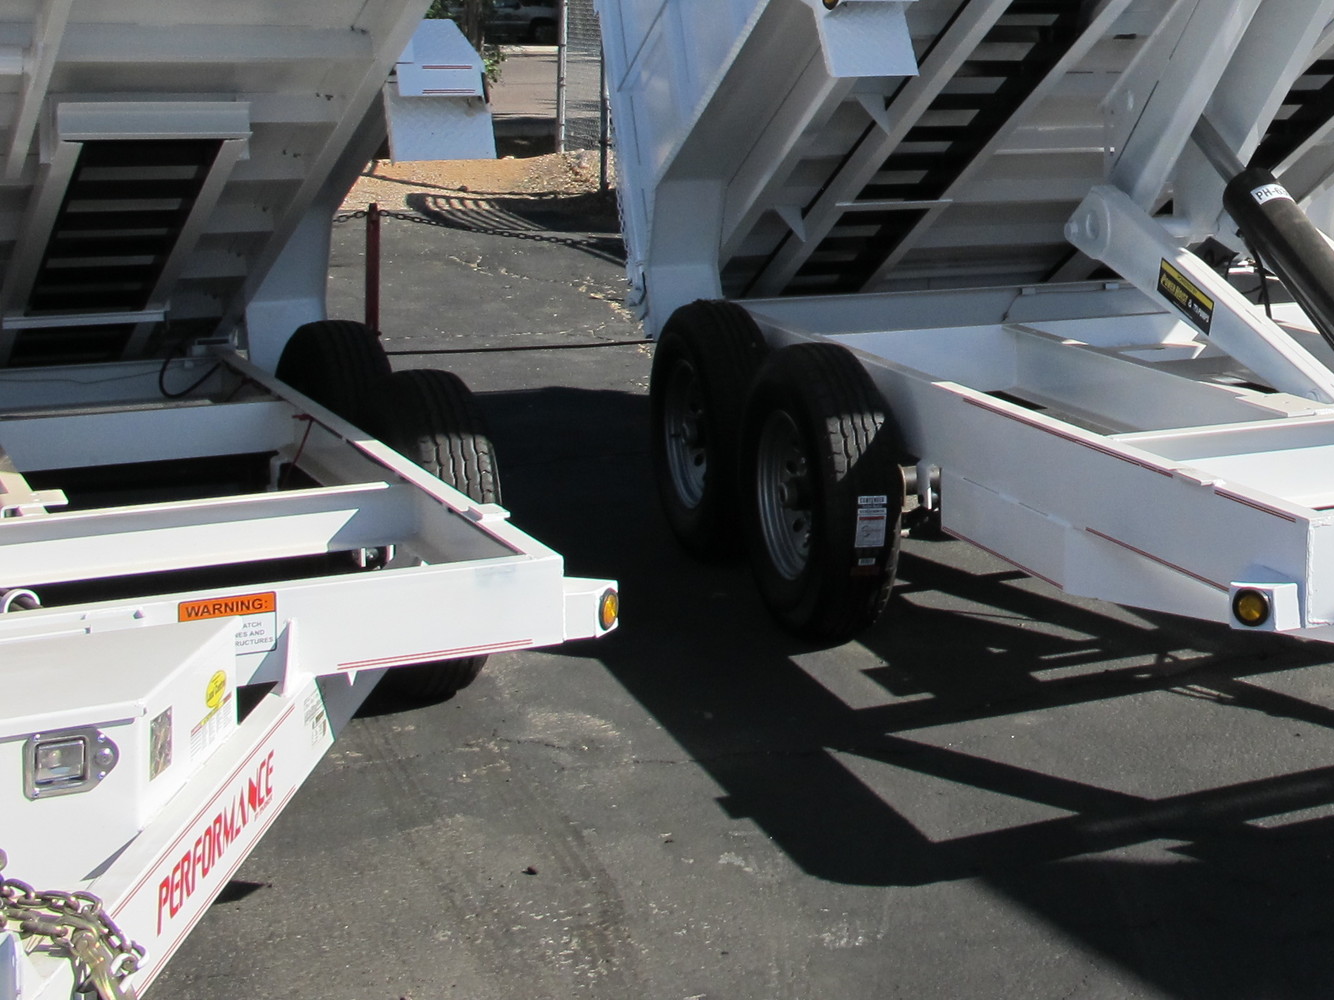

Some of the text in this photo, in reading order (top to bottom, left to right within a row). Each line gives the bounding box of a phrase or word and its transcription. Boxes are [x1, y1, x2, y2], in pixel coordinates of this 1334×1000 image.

[185, 598, 268, 618] WARNING:
[242, 621, 262, 630] ATCH
[249, 629, 265, 638] AND
[235, 637, 274, 647] RUCTURES
[157, 749, 275, 937] PERFORMANCE
